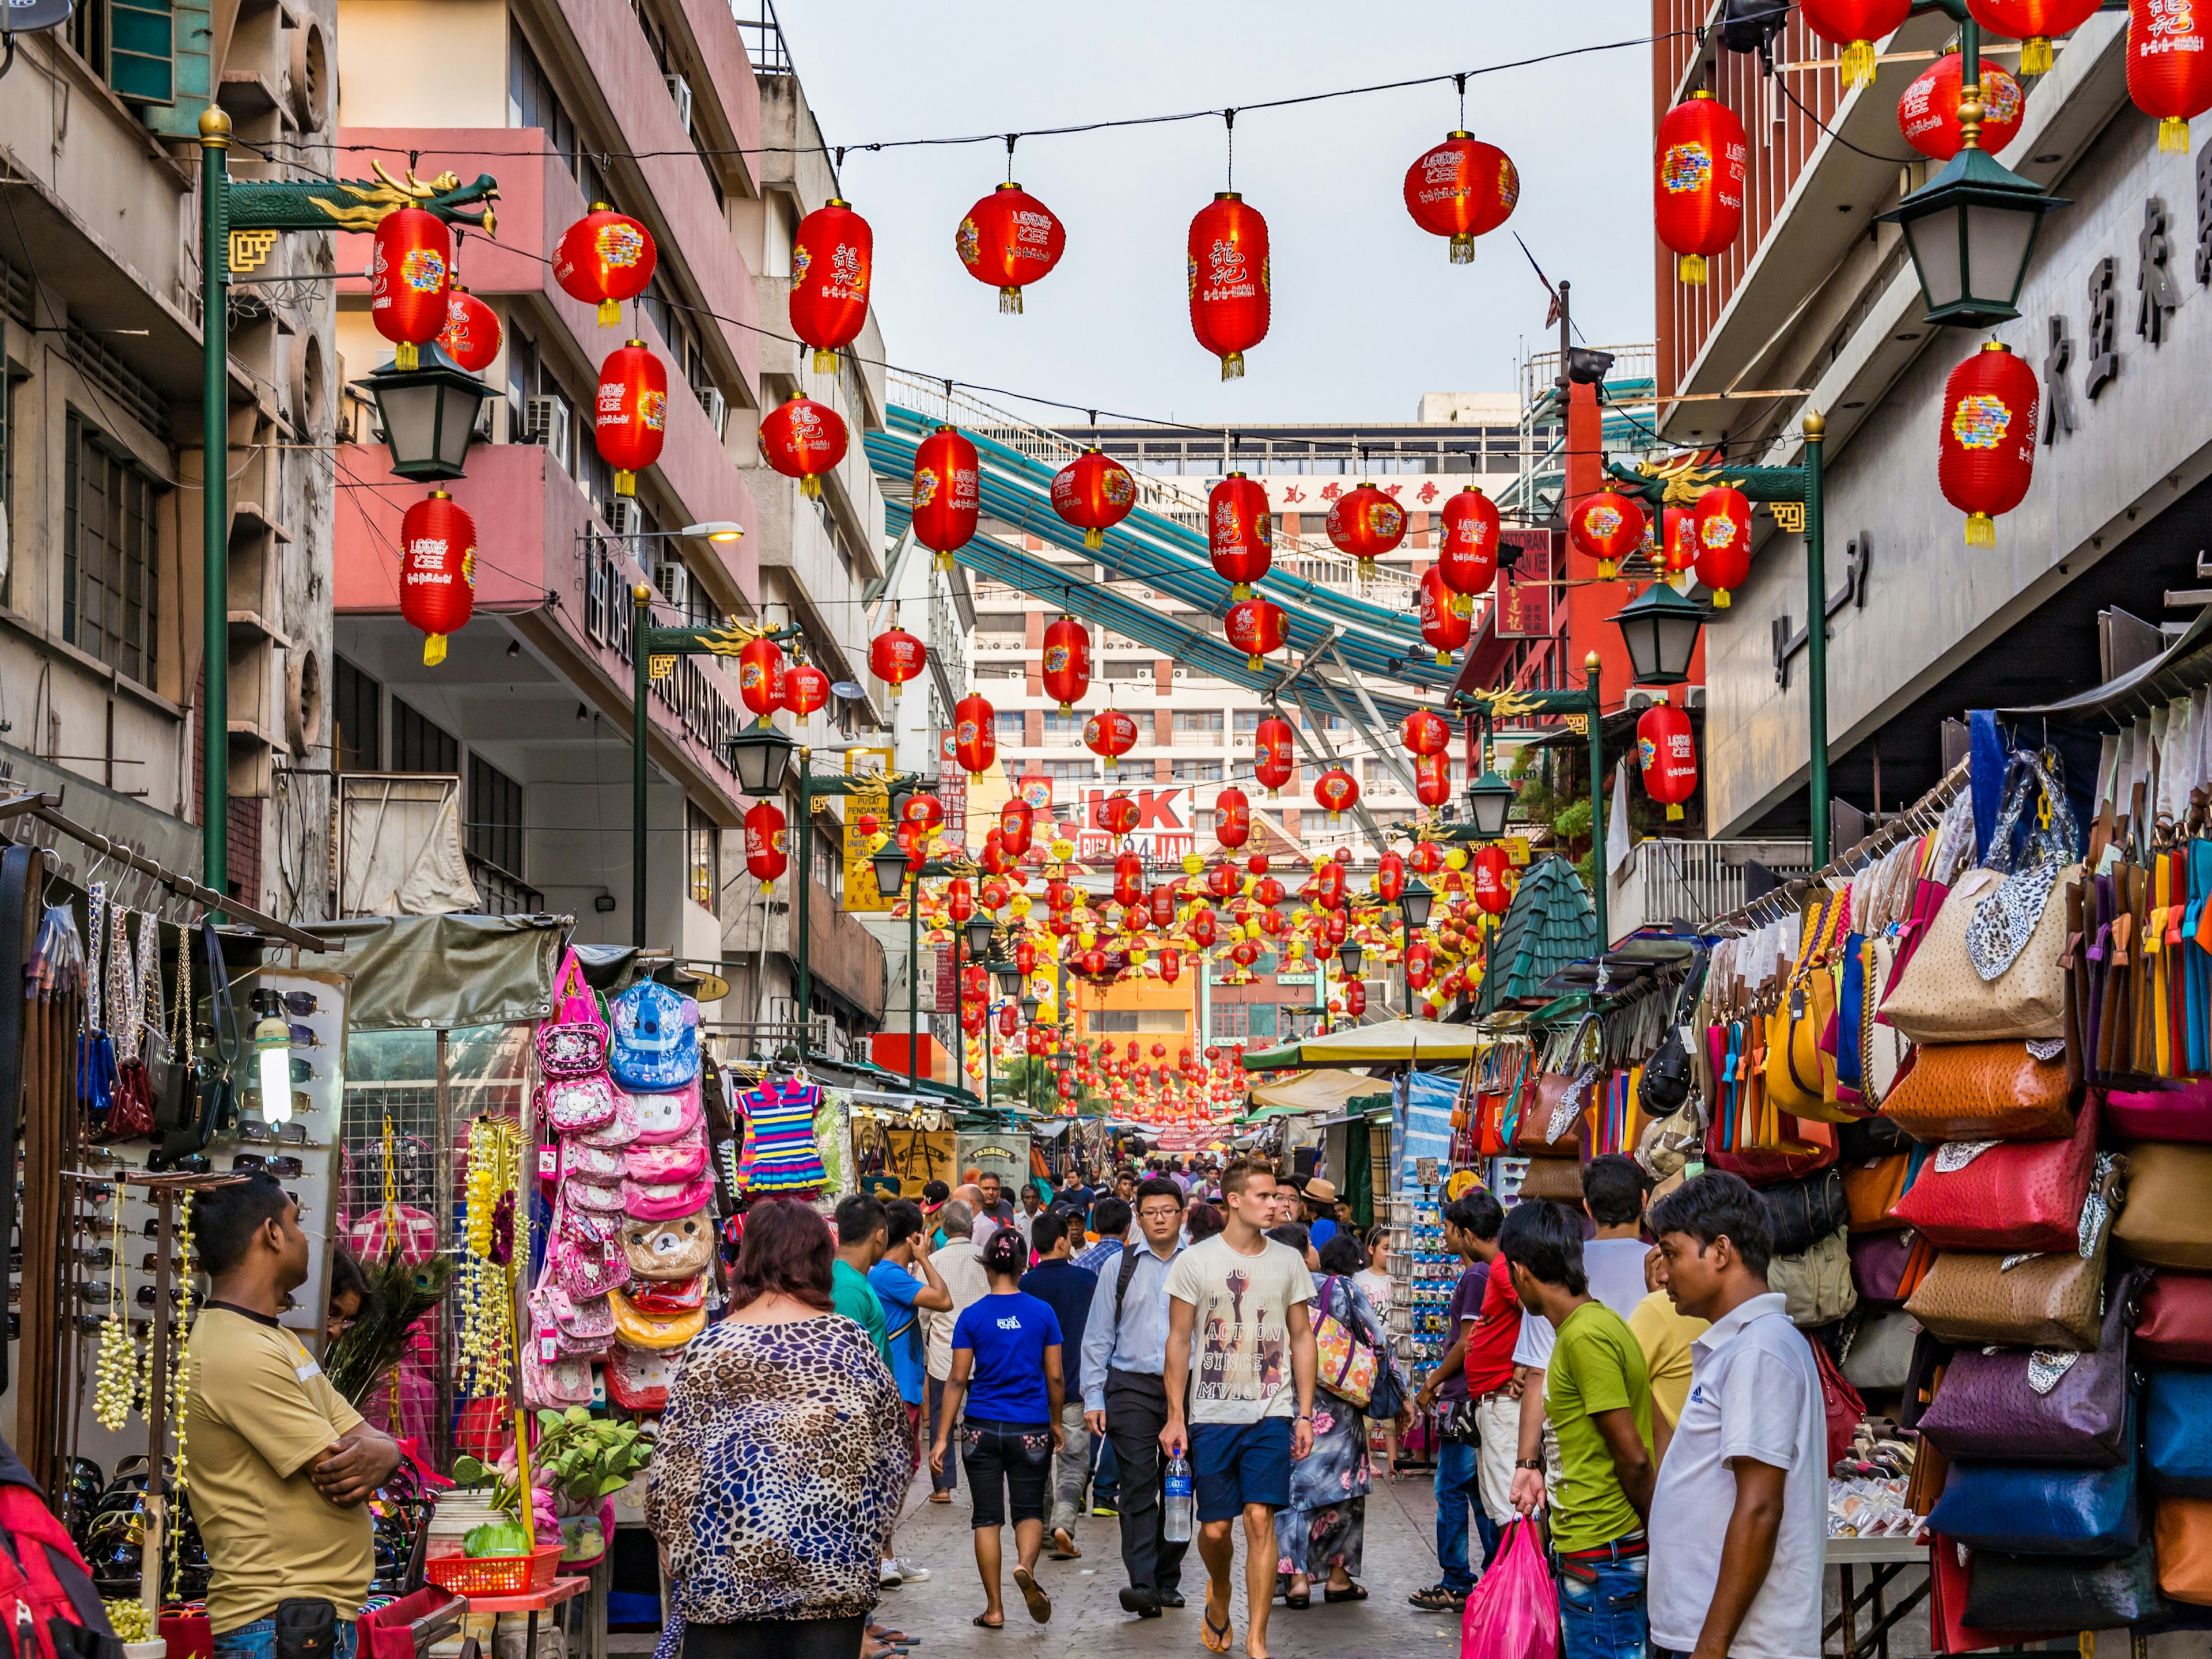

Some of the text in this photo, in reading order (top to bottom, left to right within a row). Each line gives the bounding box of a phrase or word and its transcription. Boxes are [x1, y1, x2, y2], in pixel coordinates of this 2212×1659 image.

[1904, 96, 1929, 119] KEE
[1421, 151, 1466, 169] LOONG
[1425, 167, 1459, 184] KEE
[1012, 210, 1052, 230] LOONG
[1017, 226, 1048, 245] KEE
[831, 243, 862, 287] 龍記
[1209, 239, 1247, 286] 龍記
[597, 382, 626, 399] LOONG
[600, 398, 622, 412] KEE
[789, 406, 823, 438] 龍記
[1215, 501, 1241, 545] 龍記
[1457, 518, 1488, 534] LOONG
[410, 539, 449, 555] LOONG
[1460, 531, 1484, 545] KEE
[414, 555, 444, 569] KEE
[1535, 553, 1547, 573] KEE
[1236, 608, 1256, 634] 龍記
[891, 641, 915, 652] LOONG
[684, 657, 712, 751] LUEN
[1667, 734, 1691, 747] LOONG
[1672, 747, 1691, 757] KEE
[858, 798, 880, 806] PUSAT
[1157, 837, 1192, 865] JAM
[974, 1146, 1012, 1159] FRESHLY
[1418, 1171, 1423, 1184] 3
[1429, 1170, 1439, 1184] 15
[1243, 1291, 1282, 1310] FOR
[1207, 1322, 1281, 1342] ACTION
[1203, 1353, 1263, 1371] SINCE
[1198, 1381, 1280, 1400] MV1976
